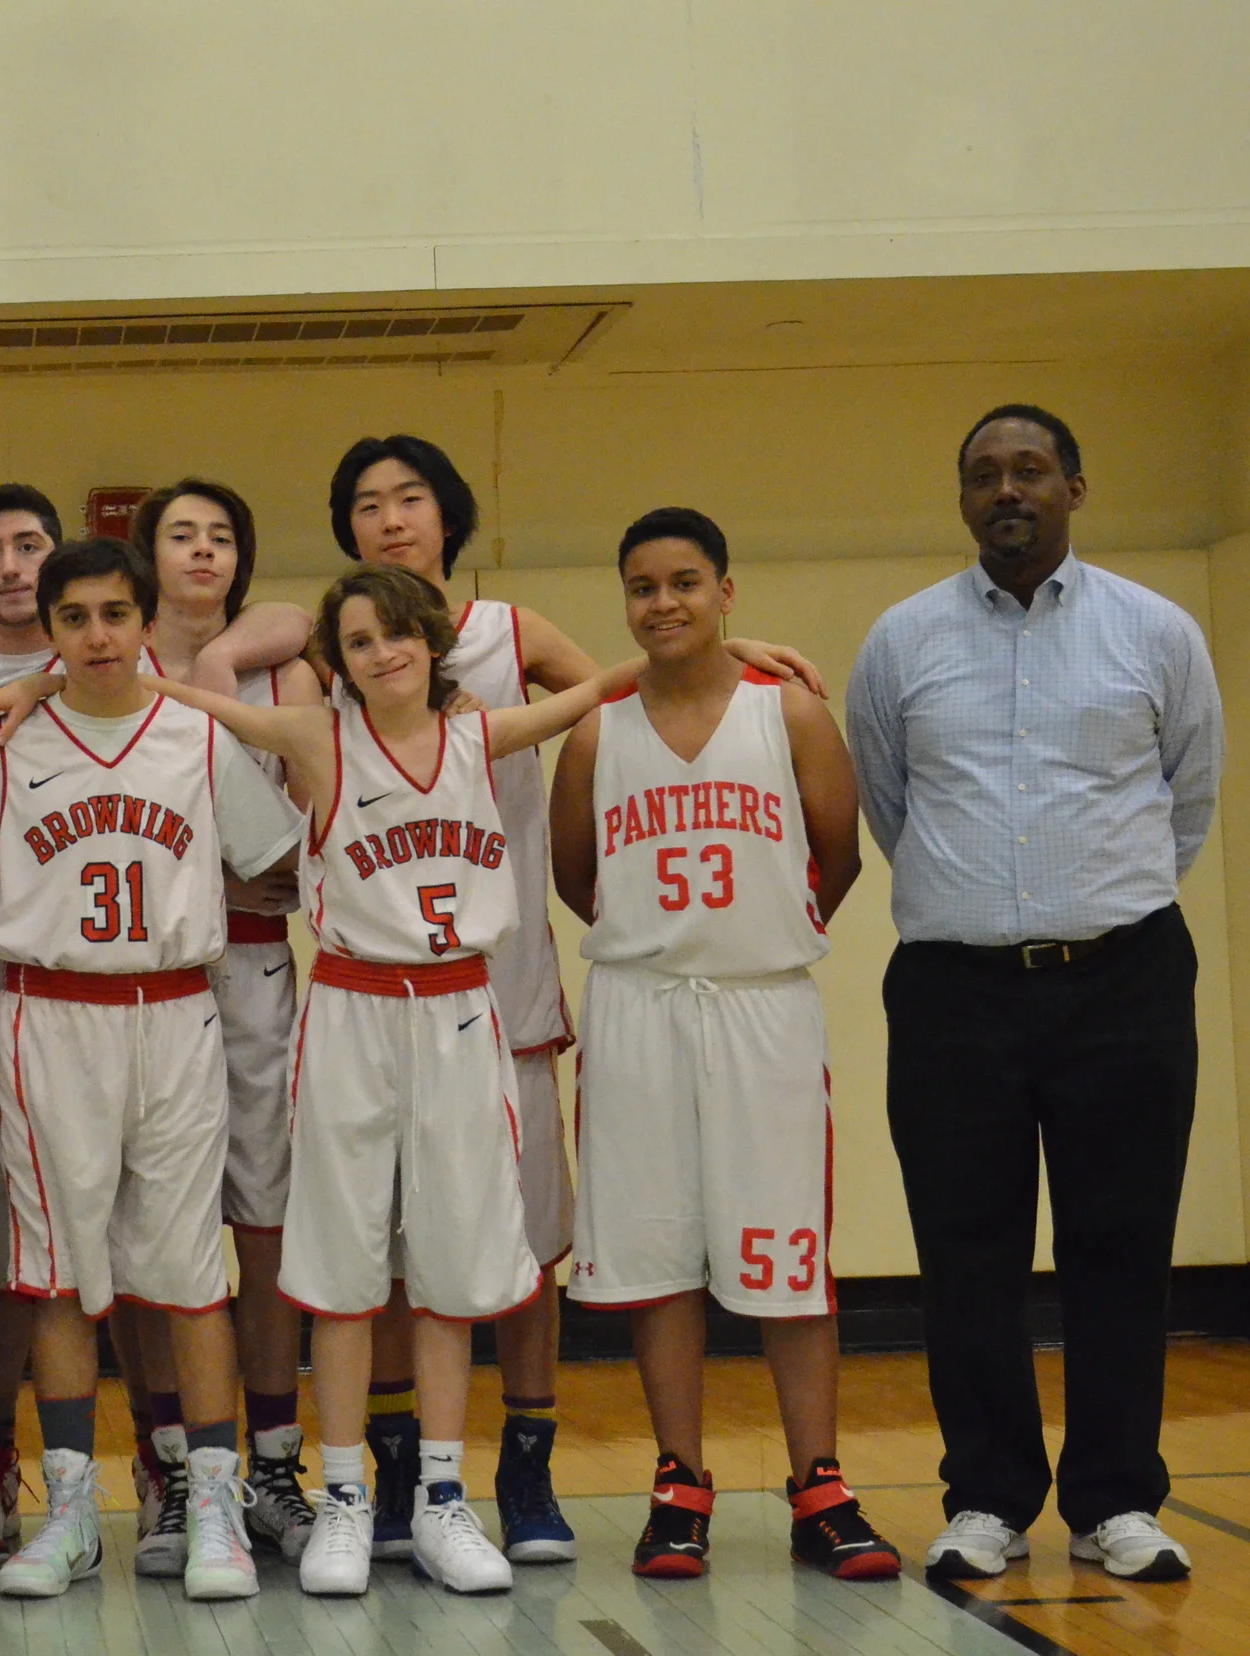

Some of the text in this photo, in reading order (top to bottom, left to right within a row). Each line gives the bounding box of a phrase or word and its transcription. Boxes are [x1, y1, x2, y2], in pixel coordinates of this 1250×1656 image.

[23, 793, 194, 866] BROWNING
[604, 781, 783, 857] PANTHERS
[80, 861, 148, 943] 31
[657, 843, 734, 912] 53
[416, 882, 461, 957] 5
[739, 1227, 817, 1292] 53
